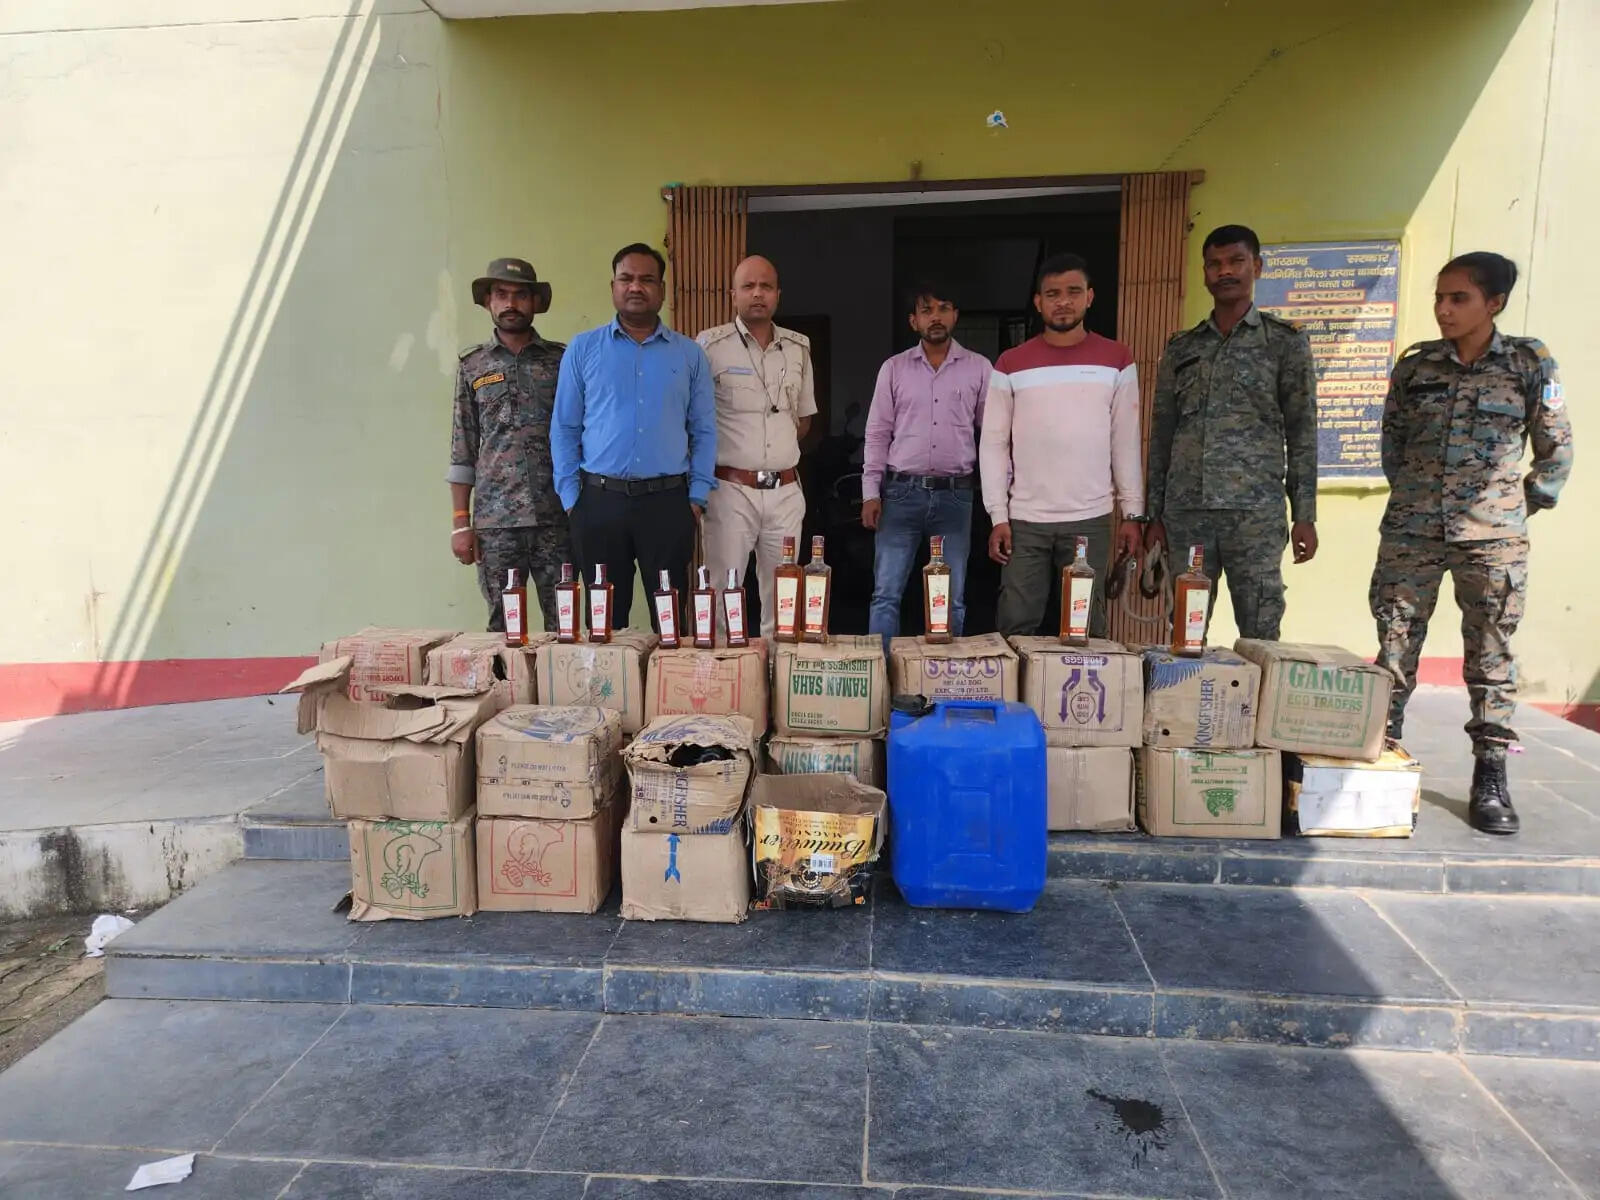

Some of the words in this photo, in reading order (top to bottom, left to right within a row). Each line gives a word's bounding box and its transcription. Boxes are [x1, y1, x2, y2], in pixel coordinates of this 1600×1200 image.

[1346, 253, 1390, 264] सरकार
[1304, 267, 1328, 278] जिला
[928, 659, 996, 676] SEPL
[1289, 661, 1365, 695] GANGA
[792, 674, 823, 696] SAHA
[826, 676, 868, 698] RAMAN
[1193, 678, 1217, 747] KINGFISHER
[1312, 695, 1363, 712] TRADERS
[671, 770, 689, 828] NGFISHER
